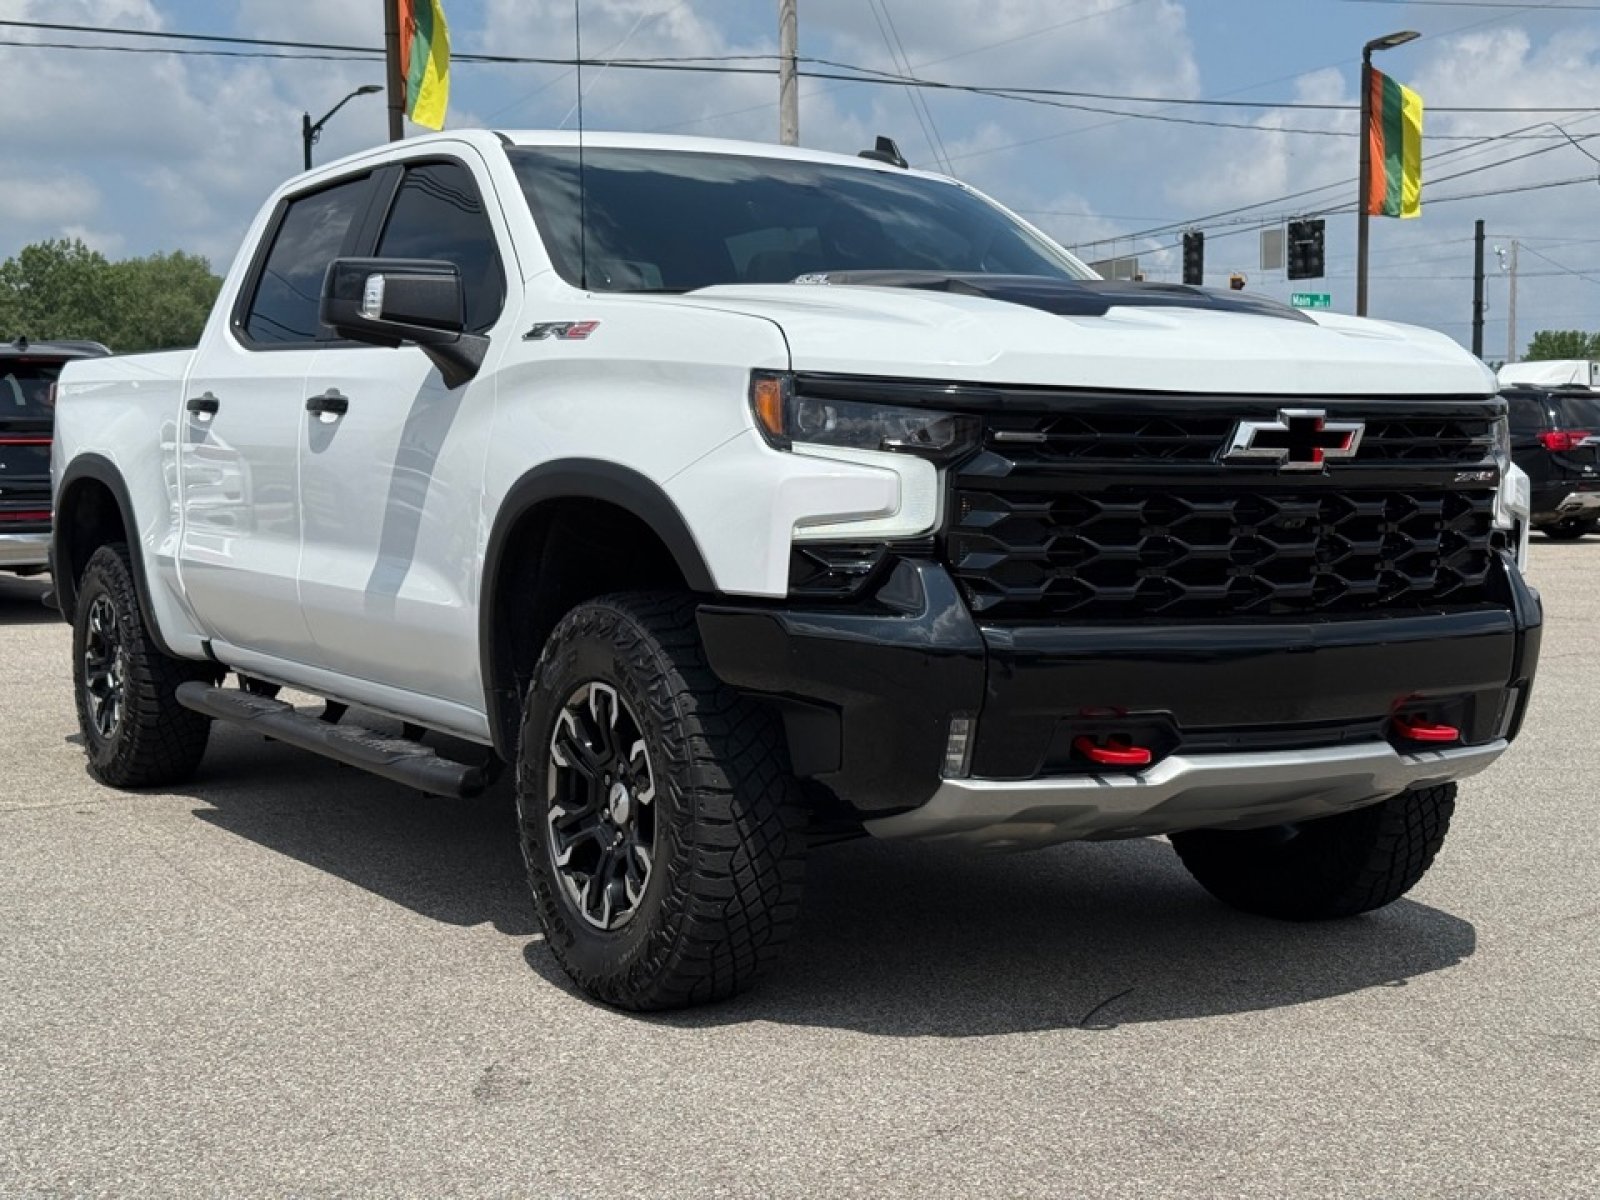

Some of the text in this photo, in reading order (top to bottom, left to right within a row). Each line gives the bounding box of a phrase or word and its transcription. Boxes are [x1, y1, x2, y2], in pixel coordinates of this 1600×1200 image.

[1292, 294, 1310, 306] Main
[521, 321, 600, 341] ZR2
[1455, 471, 1494, 482] ZR2
